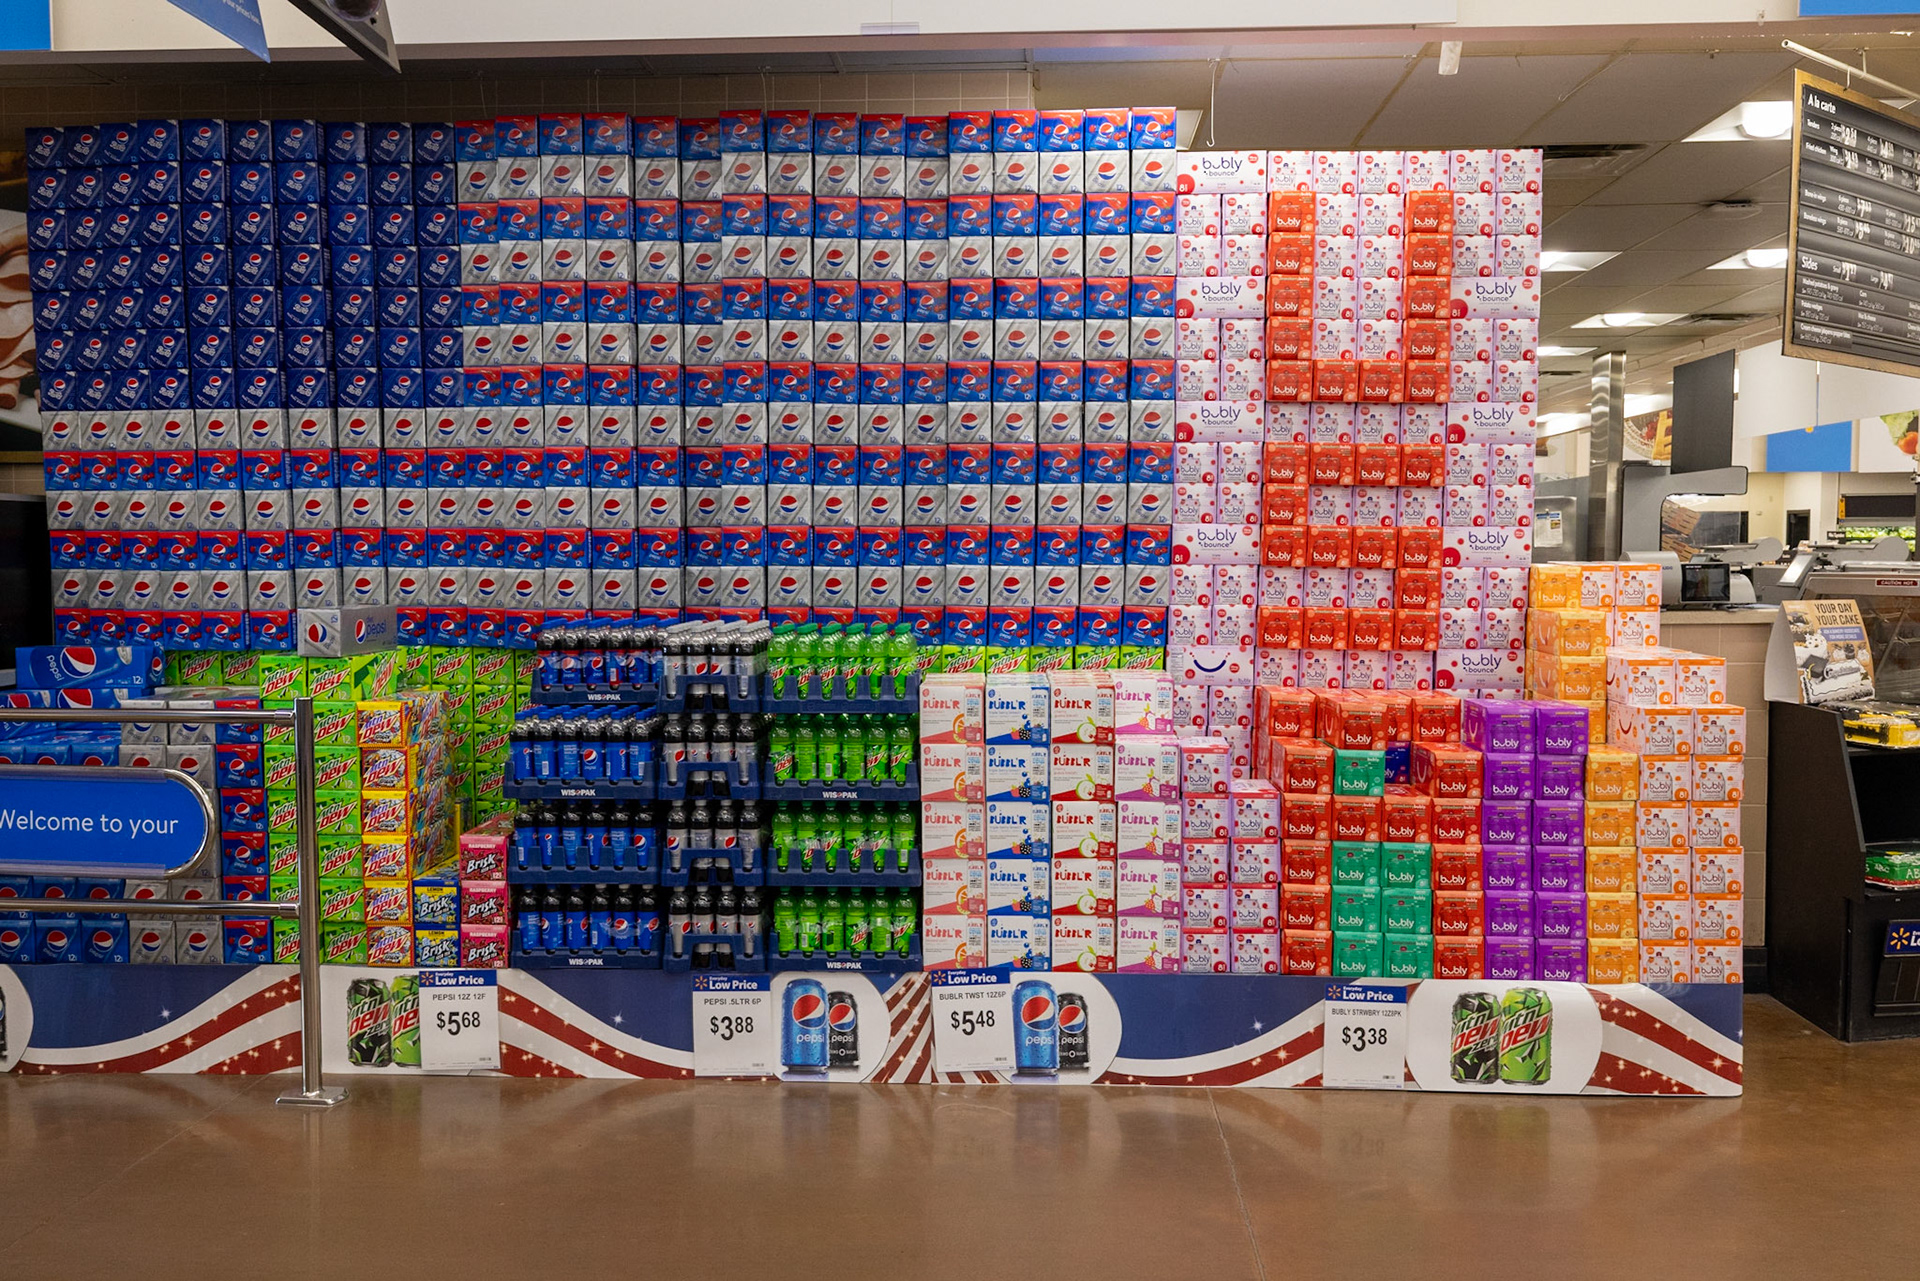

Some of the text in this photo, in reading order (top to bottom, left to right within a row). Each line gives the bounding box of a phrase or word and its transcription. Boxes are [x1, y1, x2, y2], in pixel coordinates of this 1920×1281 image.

[1808, 94, 1814, 106] A
[1820, 101, 1836, 114] carte
[1203, 156, 1243, 174] bubly
[1209, 169, 1235, 177] bounce
[1802, 256, 1818, 271] Sides
[1202, 282, 1242, 299] bubly
[1208, 294, 1235, 302] bounce
[1476, 282, 1516, 300] bubly
[1482, 295, 1510, 303] bounce
[1201, 406, 1241, 424] bubly
[1473, 407, 1514, 425] bubly
[1197, 529, 1237, 547] bubly
[1468, 531, 1509, 550] bubly
[1474, 544, 1501, 552] bounce
[1815, 603, 1853, 614] YOUR DAY
[1816, 614, 1860, 625] YOUR CAKE
[367, 620, 386, 637] pepsi
[46, 655, 65, 681] pepsi
[1461, 654, 1502, 671] bubly
[1468, 666, 1495, 674] bounce
[0, 809, 179, 839] Welcome to your
[466, 854, 495, 873] Brisk
[420, 896, 448, 916] Brisk
[468, 897, 496, 917] Brisk
[421, 941, 450, 961] Brisk
[468, 942, 496, 962] Brisk
[435, 974, 484, 985] Low Price
[709, 980, 758, 990] Low Price
[948, 972, 997, 984] Low Price
[939, 992, 963, 1000] BUBLR
[1343, 990, 1394, 1001] Low Price
[1332, 1008, 1351, 1016] BUBLY
[796, 1033, 825, 1044] pepsi
[831, 1034, 854, 1044] pepsi
[1025, 1036, 1054, 1046] pepsi
[1061, 1036, 1084, 1045] pepsi
